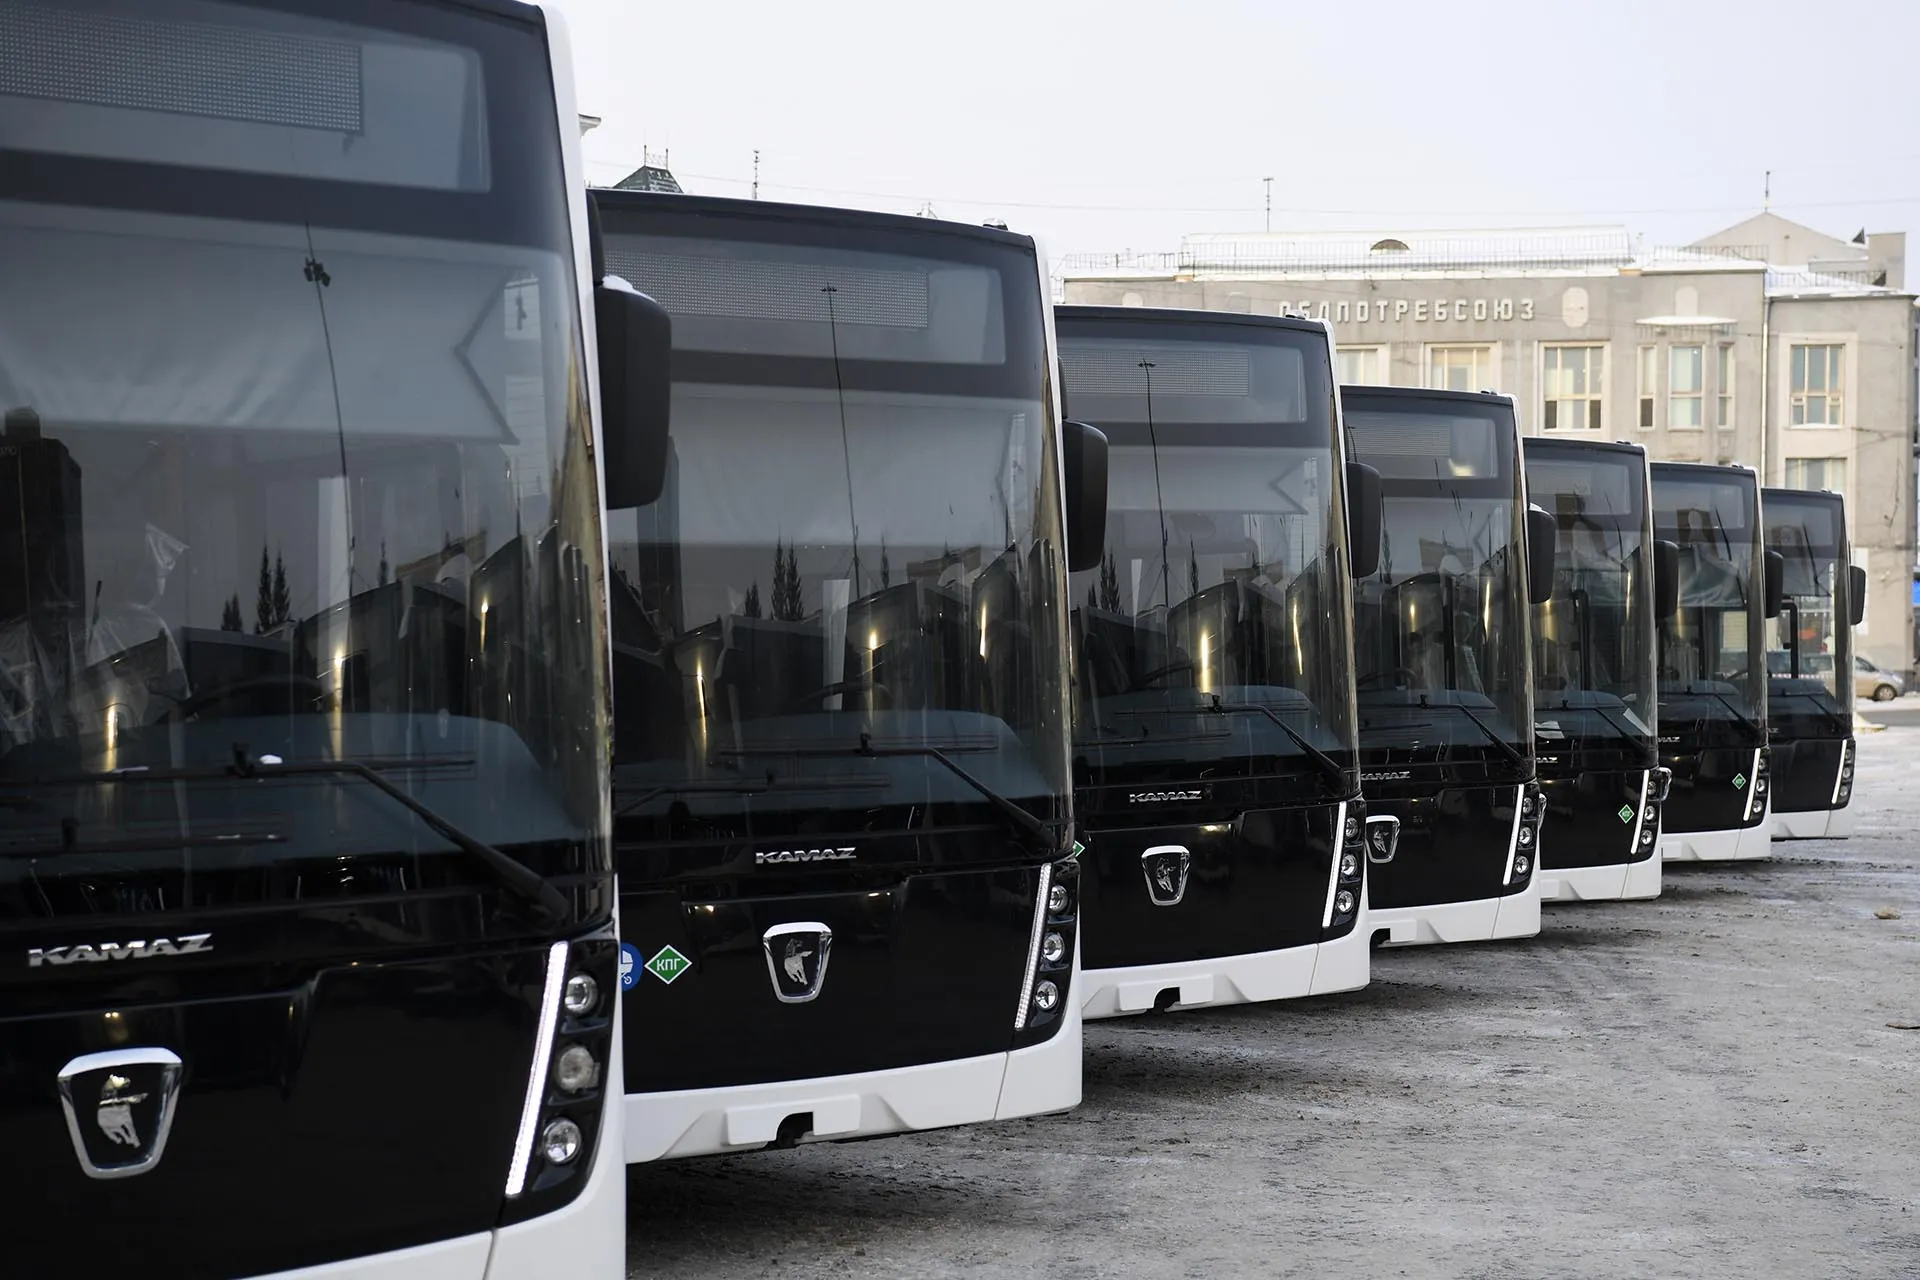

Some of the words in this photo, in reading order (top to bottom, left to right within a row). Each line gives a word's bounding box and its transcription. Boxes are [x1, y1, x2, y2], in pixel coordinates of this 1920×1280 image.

[1129, 790, 1202, 803] KAMAZ
[755, 846, 857, 864] KAMAZ
[28, 932, 214, 967] KAMAZ
[656, 958, 681, 971] КПГ
